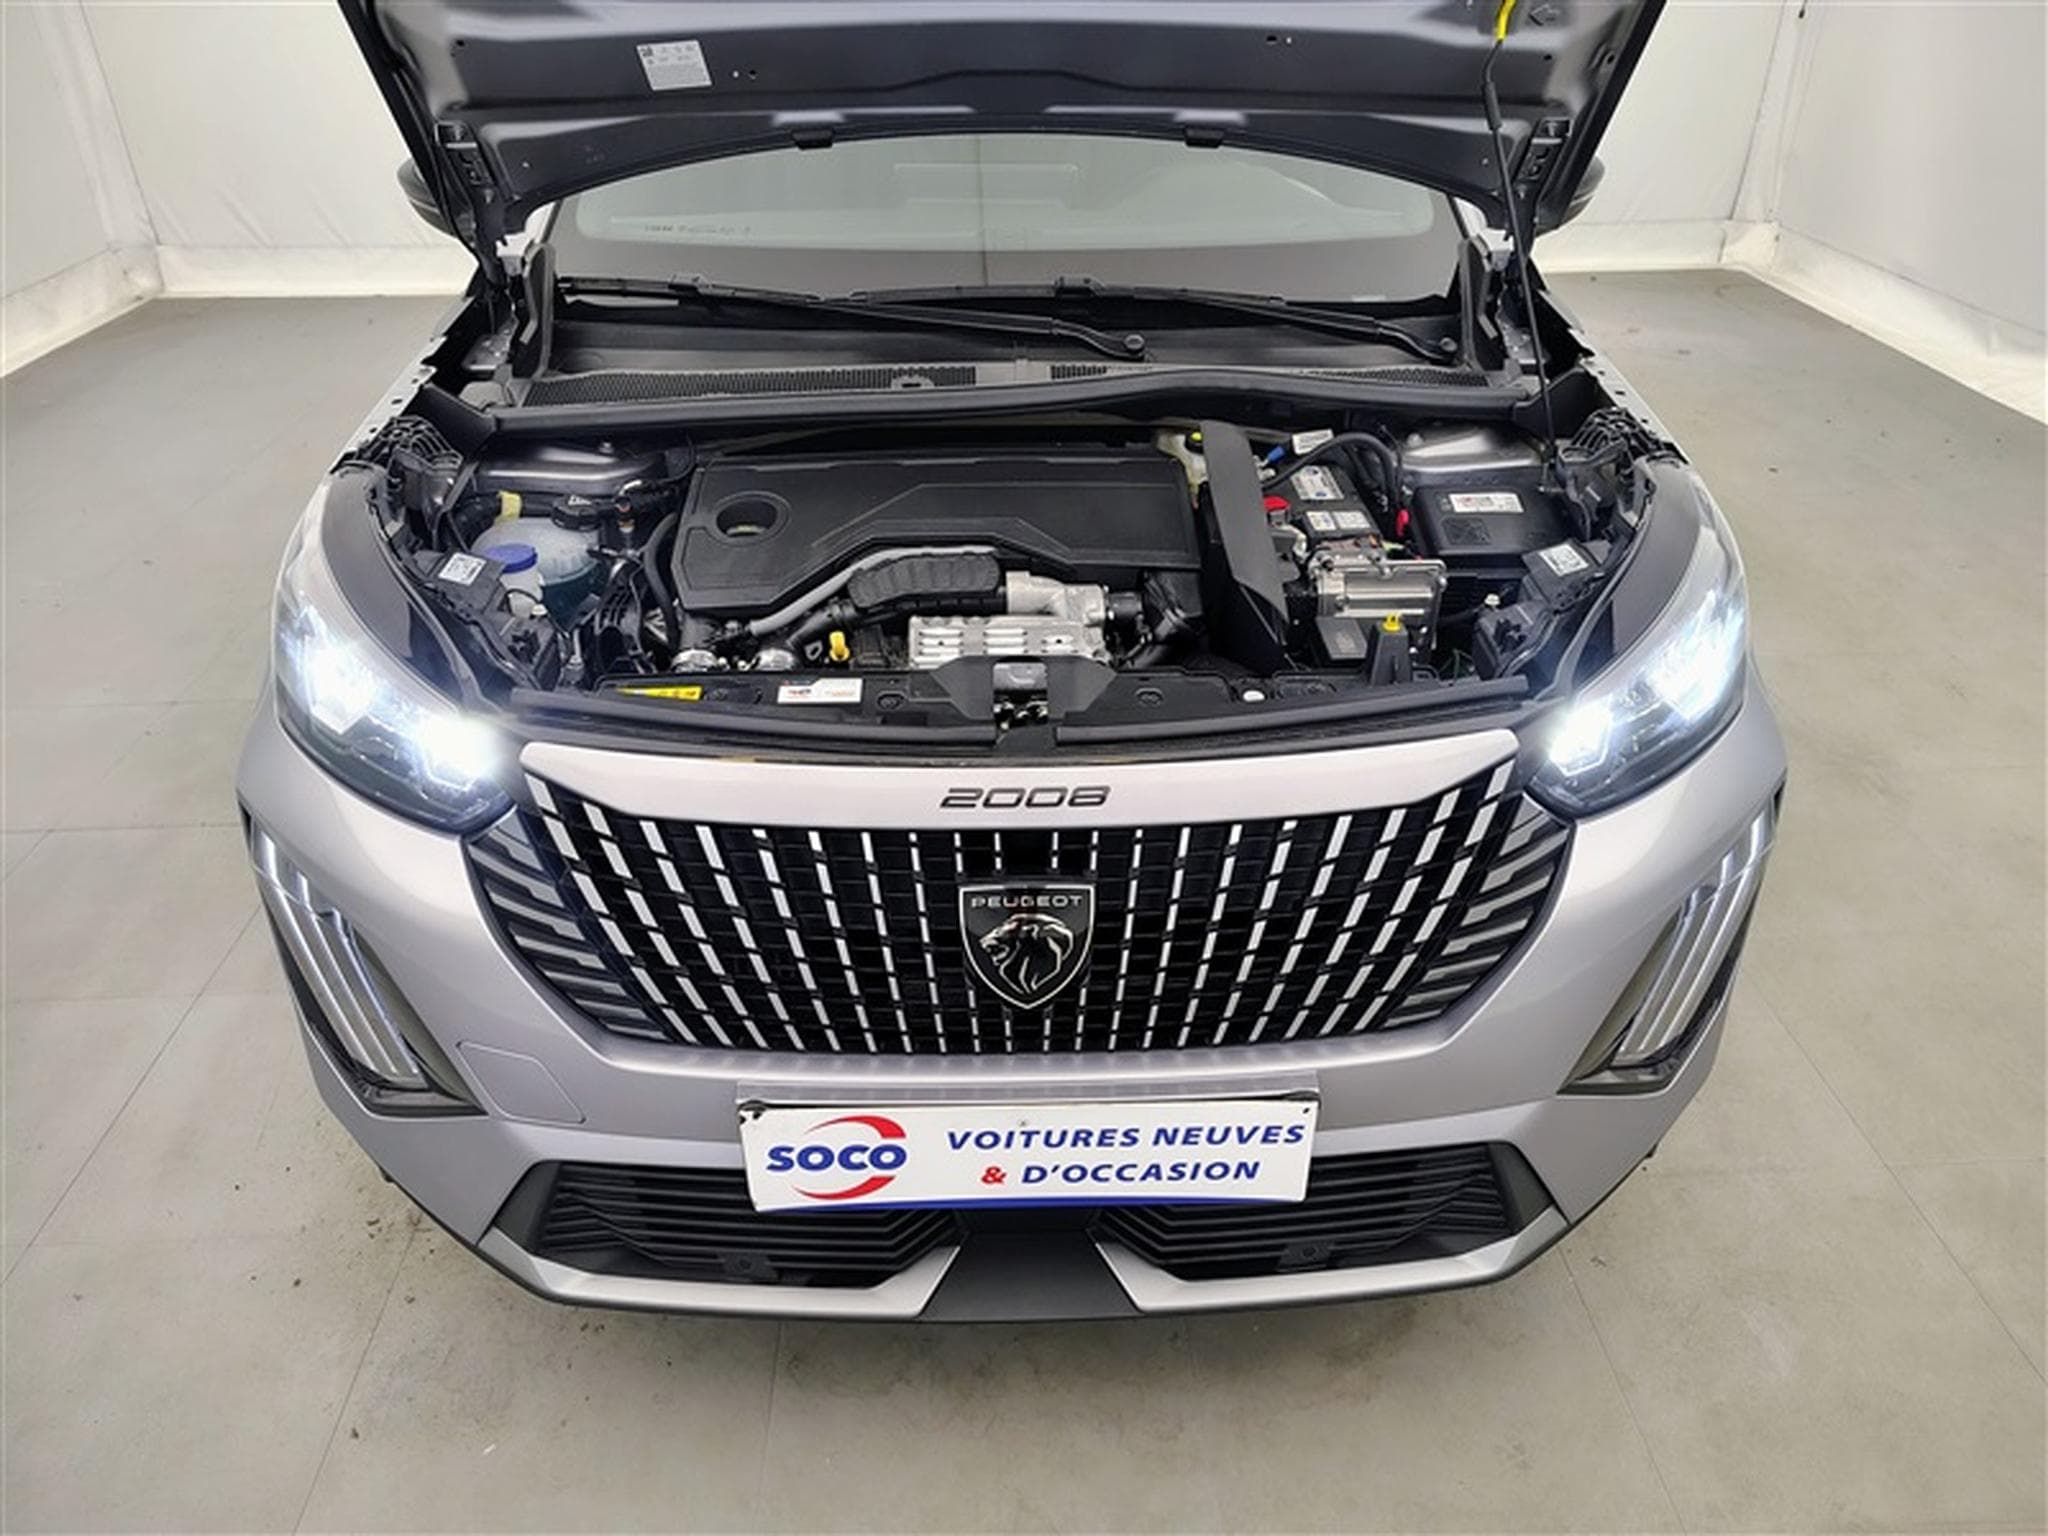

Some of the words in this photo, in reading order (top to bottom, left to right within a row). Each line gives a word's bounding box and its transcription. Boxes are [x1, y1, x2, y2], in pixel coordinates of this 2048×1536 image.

[940, 786, 1111, 808] 2008
[971, 895, 1083, 908] PEUGEOT
[947, 1127, 1141, 1152] VOITURES
[1152, 1123, 1305, 1148] NEUVES
[765, 1143, 908, 1173] SOCO
[980, 1165, 1007, 1186] &
